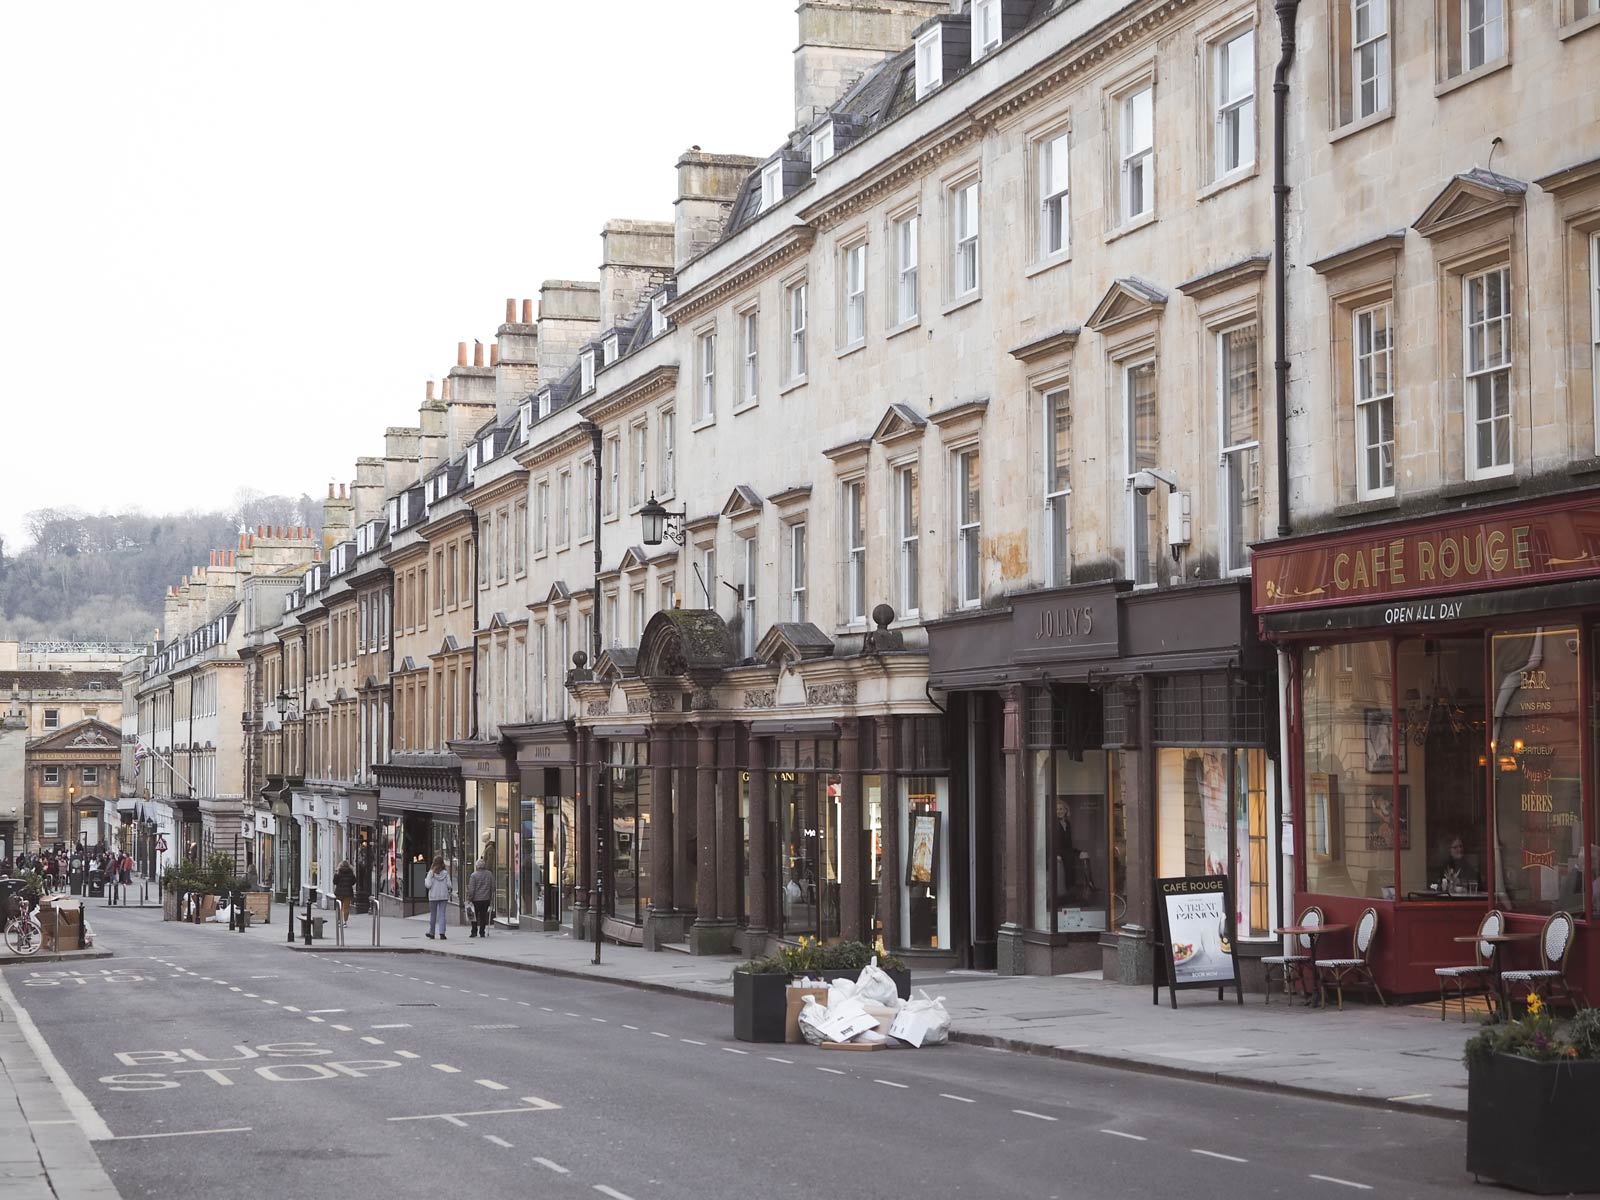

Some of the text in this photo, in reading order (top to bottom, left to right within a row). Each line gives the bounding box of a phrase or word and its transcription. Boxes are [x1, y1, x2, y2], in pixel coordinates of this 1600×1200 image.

[1333, 526, 1531, 591] CAFÉ ROUGE
[1385, 602, 1463, 624] OPEN ALL DAY
[1520, 671, 1550, 690] BAR
[1520, 702, 1552, 711] VINS FINS
[1521, 790, 1553, 812] BIÈRES
[1190, 880, 1224, 891] ROUGE
[1176, 903, 1217, 913] A TREAT
[112, 1041, 334, 1067] BUS
[97, 1059, 402, 1092] STOP
